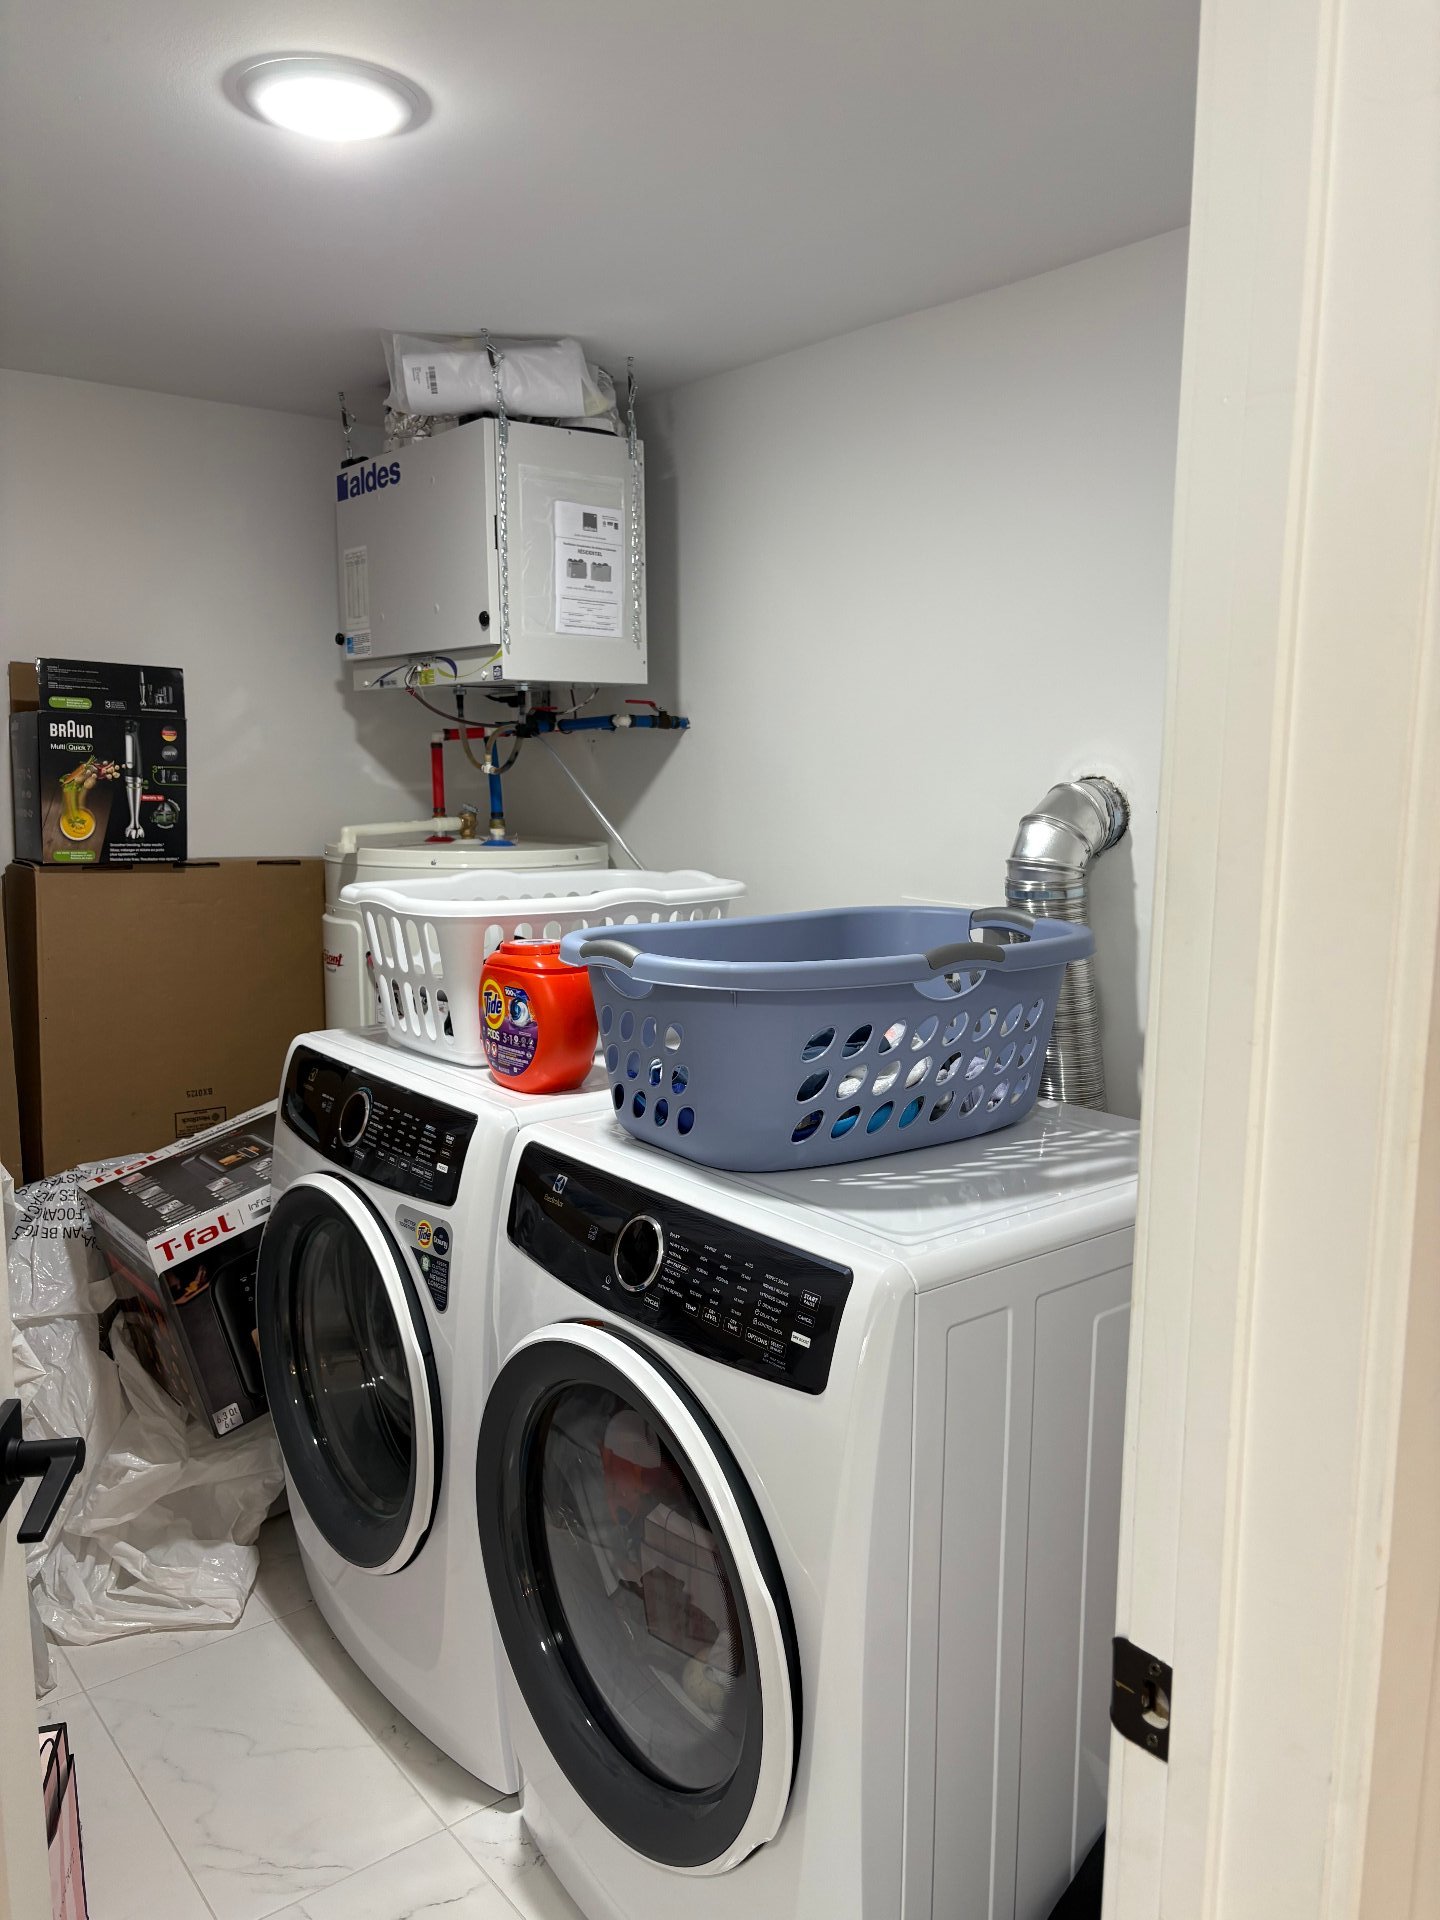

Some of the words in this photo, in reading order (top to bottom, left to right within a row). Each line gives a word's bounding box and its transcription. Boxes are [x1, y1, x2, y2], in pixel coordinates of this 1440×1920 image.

[350, 462, 400, 498] aldes
[50, 720, 93, 739] BRAUN
[484, 992, 502, 1017] Tide
[488, 1028, 500, 1041] PODS
[154, 1214, 236, 1262] T-fal
[418, 1226, 432, 1240] Tide
[434, 1236, 448, 1250] Downy
[428, 1279, 446, 1292] LONGER
[430, 1274, 446, 1286] NEWER
[804, 1294, 818, 1304] START
[686, 1302, 696, 1312] TEMP
[704, 1313, 717, 1322] LEVEL
[798, 1314, 812, 1325] CANCEL
[728, 1323, 738, 1332] TIME
[747, 1332, 768, 1346] OPTIONS
